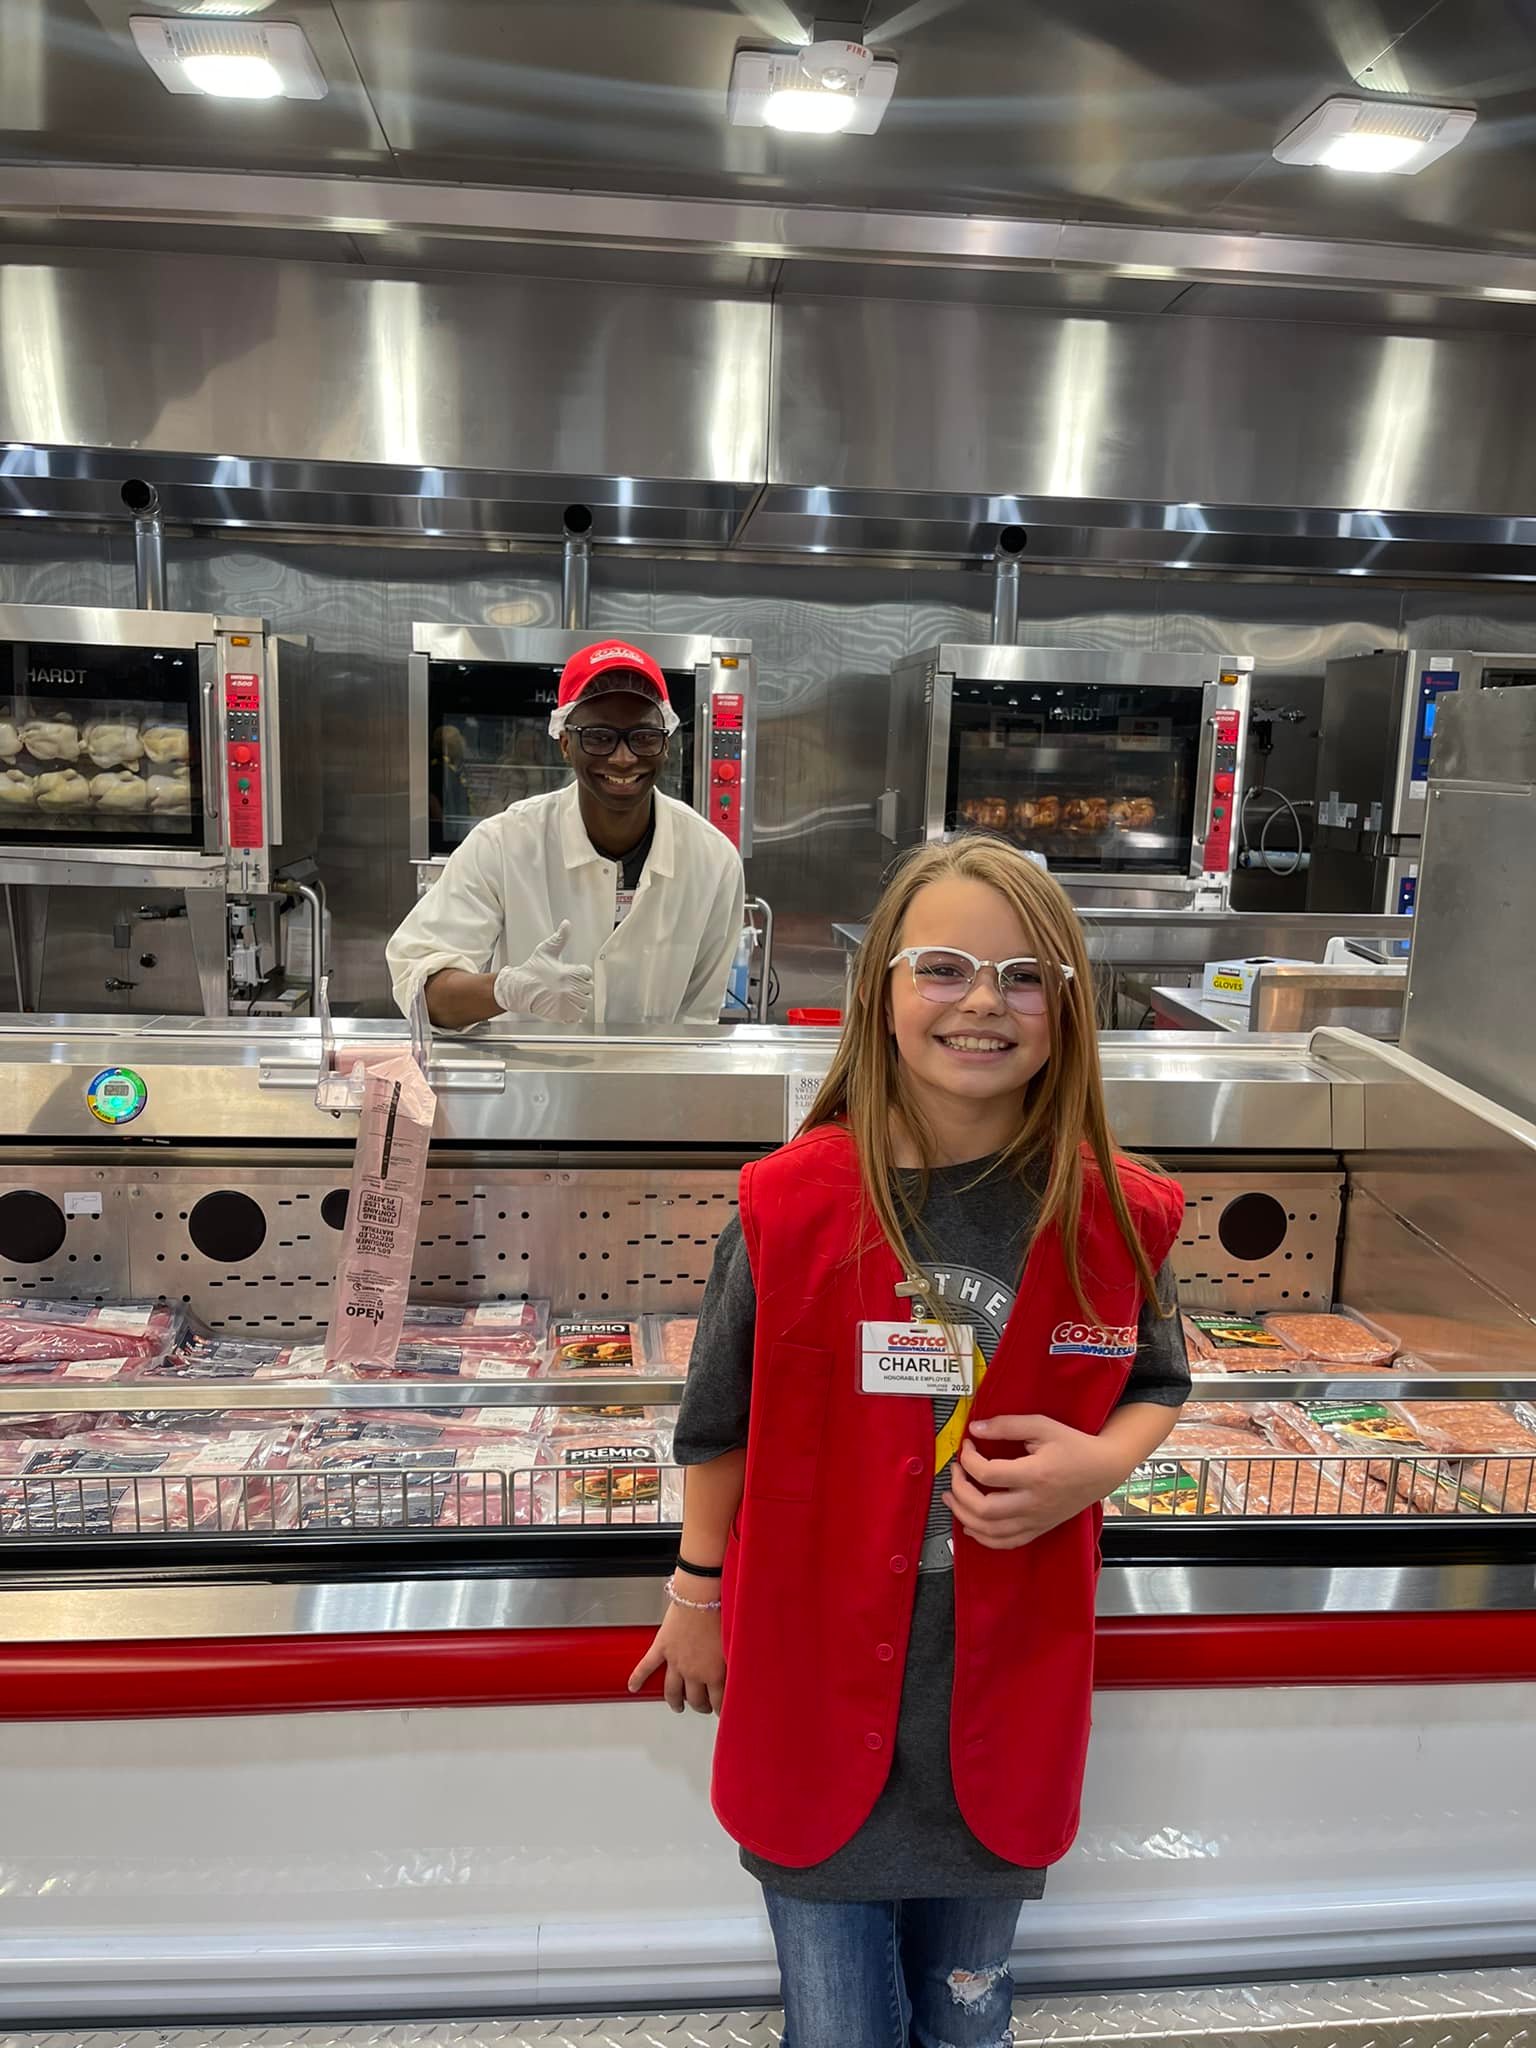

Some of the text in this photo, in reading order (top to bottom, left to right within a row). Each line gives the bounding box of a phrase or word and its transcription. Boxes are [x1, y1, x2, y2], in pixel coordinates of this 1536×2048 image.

[846, 44, 866, 58] FIRE
[535, 689, 558, 703] HA
[1213, 980, 1243, 991] GLOVES
[800, 1078, 824, 1089] 888
[367, 1194, 394, 1205] PLASTIC
[362, 1207, 397, 1218] CONTAINS
[358, 1232, 394, 1243] RECYCLED
[933, 1272, 1009, 1318] THE
[346, 1306, 385, 1321] OPEN
[560, 1325, 626, 1333] PREMIO
[888, 1333, 948, 1347] COSTCO
[878, 1357, 960, 1374] CHARLIE
[951, 1384, 970, 1392] 2022
[571, 1448, 650, 1460] PREMIO
